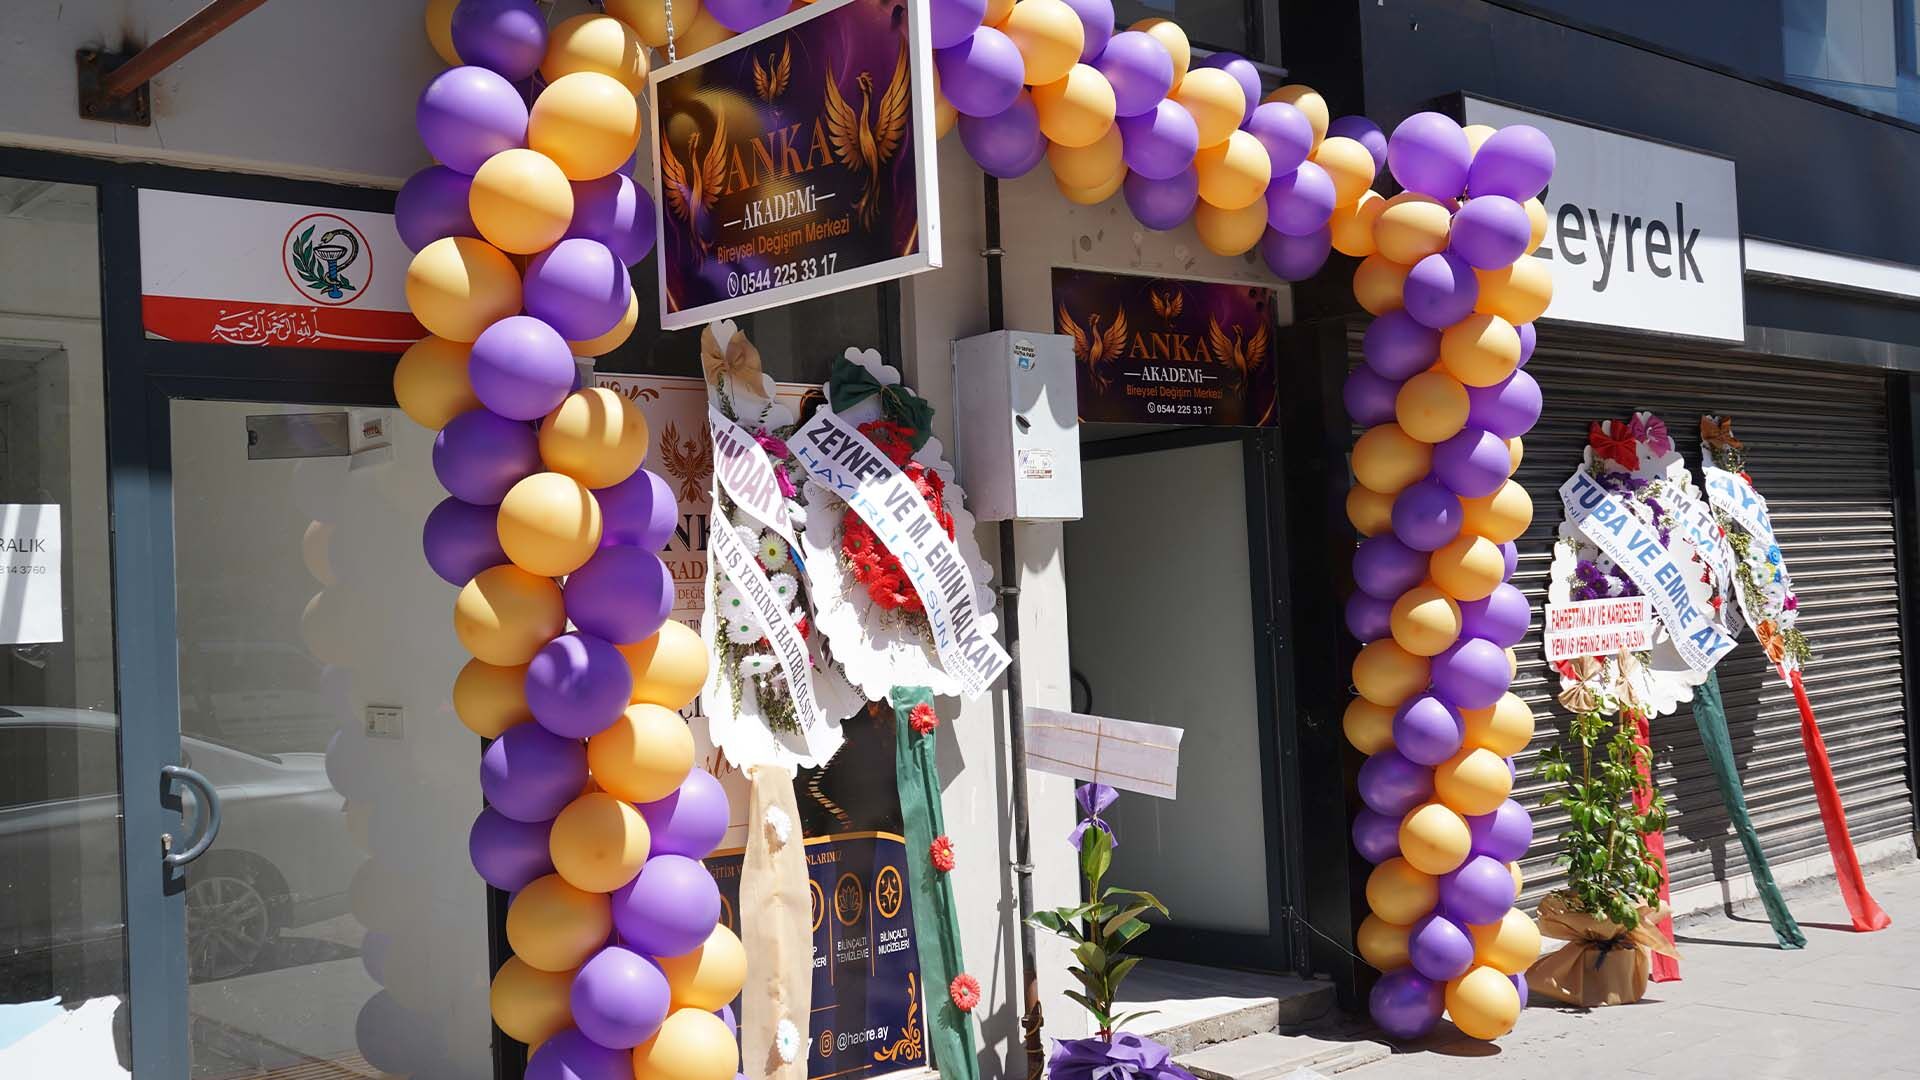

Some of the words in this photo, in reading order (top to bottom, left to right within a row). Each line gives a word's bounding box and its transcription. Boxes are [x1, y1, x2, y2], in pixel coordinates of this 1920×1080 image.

[724, 115, 836, 195] ANKA
[717, 239, 755, 264] Bireysel
[758, 229, 802, 257] Değişim
[805, 214, 850, 241] Merkezi
[741, 271, 771, 294] 0544
[774, 265, 798, 287] 225
[801, 258, 817, 280] 33
[821, 252, 837, 275] 17
[1129, 330, 1214, 362] ANKA
[1127, 384, 1158, 397] Bireysel
[1194, 387, 1223, 400] Merkezi
[1156, 405, 1175, 414] 0544
[1177, 405, 1191, 414] 225
[1192, 405, 1202, 414] 33
[1204, 406, 1213, 415] 17
[713, 515, 733, 556] ENİ
[799, 447, 898, 544] HAYIRLI
[903, 551, 949, 649] OLSUN
[806, 418, 892, 487] ZEYNEP
[884, 483, 918, 522] VE
[950, 595, 1003, 681] KALKAN
[1571, 474, 1628, 536] TUBA
[1627, 529, 1662, 567] VE
[1654, 561, 1698, 629] EMRE
[1689, 626, 1730, 656] AY
[837, 1025, 888, 1051] @hacire.ay
